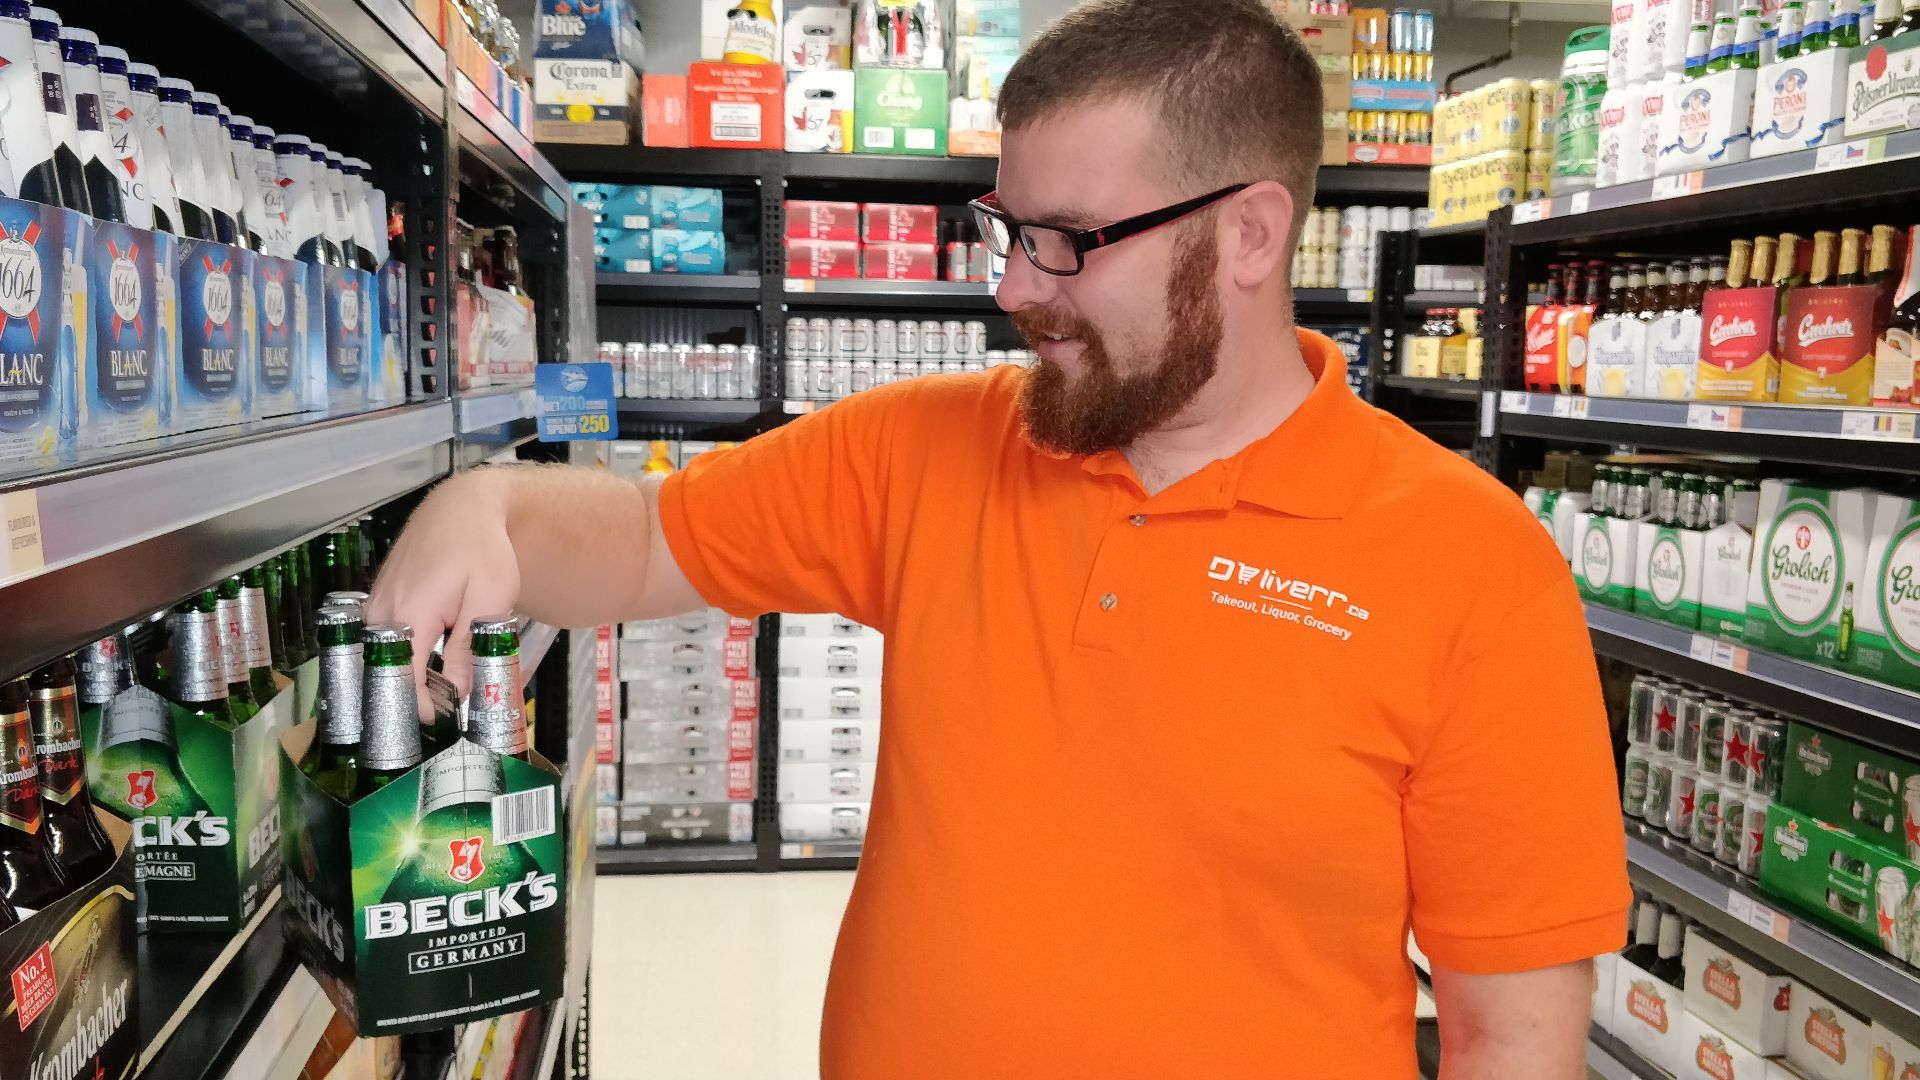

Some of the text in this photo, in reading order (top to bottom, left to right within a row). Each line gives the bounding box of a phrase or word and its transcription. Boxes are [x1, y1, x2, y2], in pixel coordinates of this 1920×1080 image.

[542, 14, 586, 36] Blue
[550, 62, 608, 80] Corona
[566, 79, 597, 91] Extra
[1773, 92, 1807, 111] PERONI
[1679, 109, 1711, 127] PERONI
[113, 272, 138, 309] 1664
[207, 286, 230, 314] 1664
[111, 349, 148, 377] BLANC
[202, 347, 234, 372] BLANC
[264, 346, 289, 368] BLANC
[0, 352, 44, 386] LANC
[560, 396, 586, 411] 200
[580, 415, 610, 434] 250
[1771, 545, 1832, 585] Grolsch
[1211, 591, 1353, 641] Takeout, Liquor, Grocery
[469, 708, 521, 723] BECK'S
[34, 735, 82, 756] rombacher
[3, 785, 41, 803] Dar
[133, 810, 231, 847] CK'S
[135, 850, 179, 862] ORTÉE
[135, 864, 193, 879] EMAGNE
[364, 870, 559, 940] BECK'S
[428, 925, 507, 949] IMPORTED
[416, 938, 519, 970] GERMANY
[30, 978, 128, 1080] Krombacher
